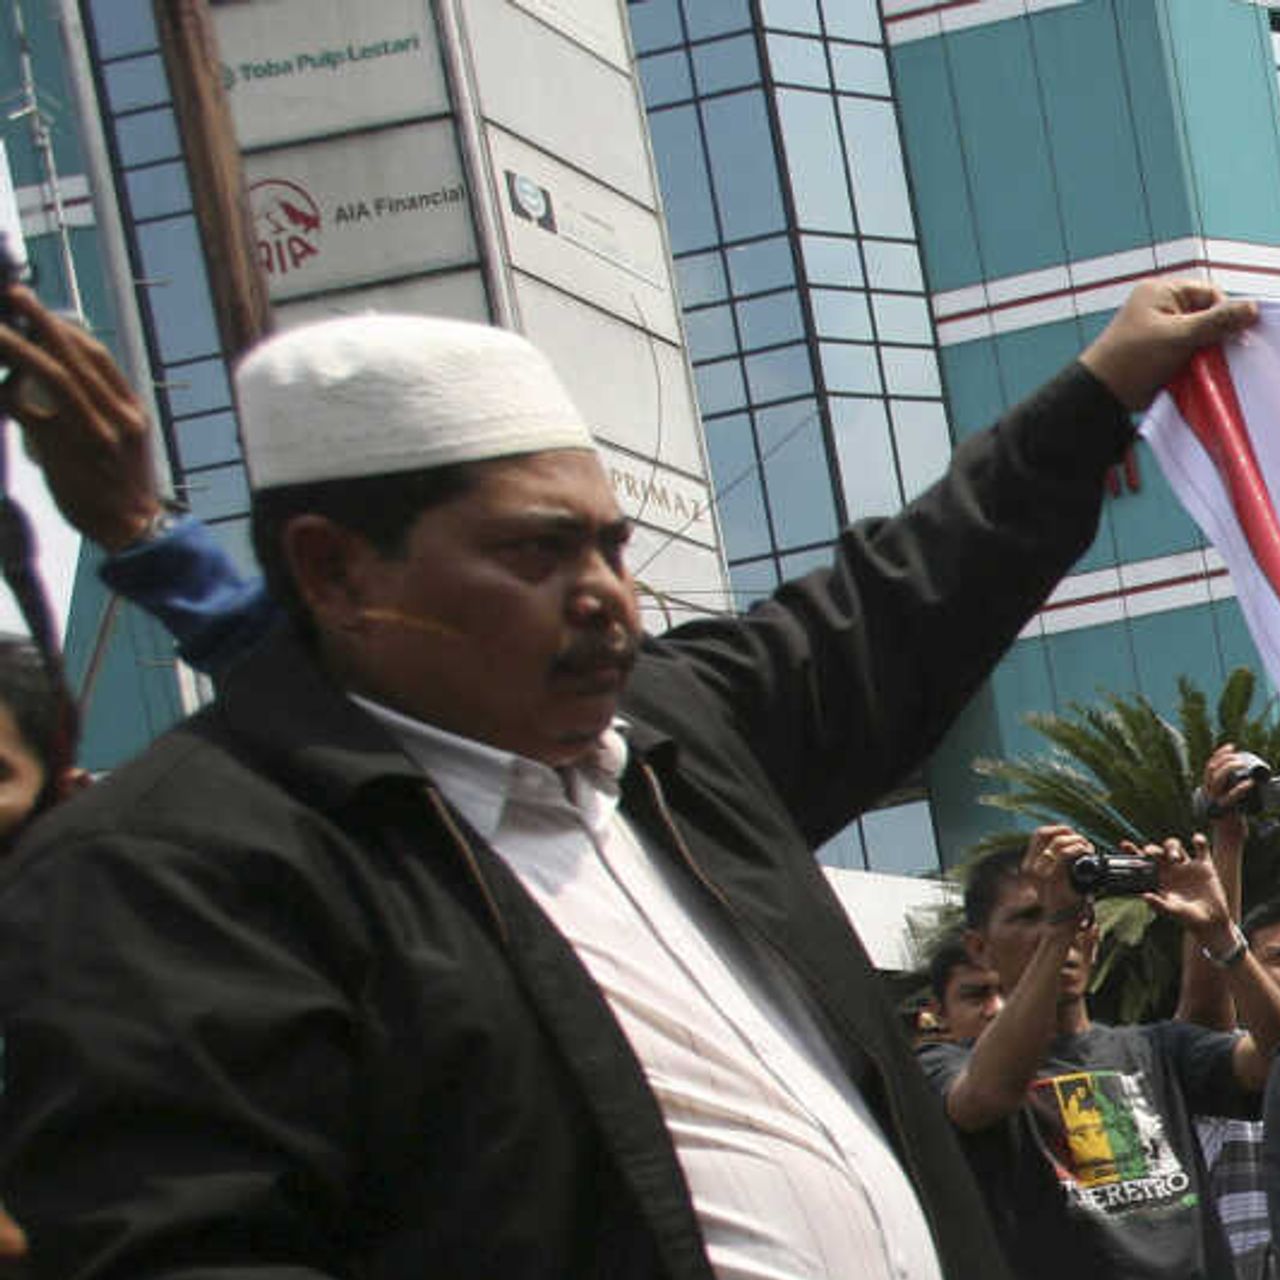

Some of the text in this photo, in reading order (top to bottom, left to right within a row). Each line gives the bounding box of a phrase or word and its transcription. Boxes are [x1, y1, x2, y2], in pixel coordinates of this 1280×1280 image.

[238, 33, 420, 80] Toba Pulp Lestari
[334, 184, 466, 224] AIA Financial
